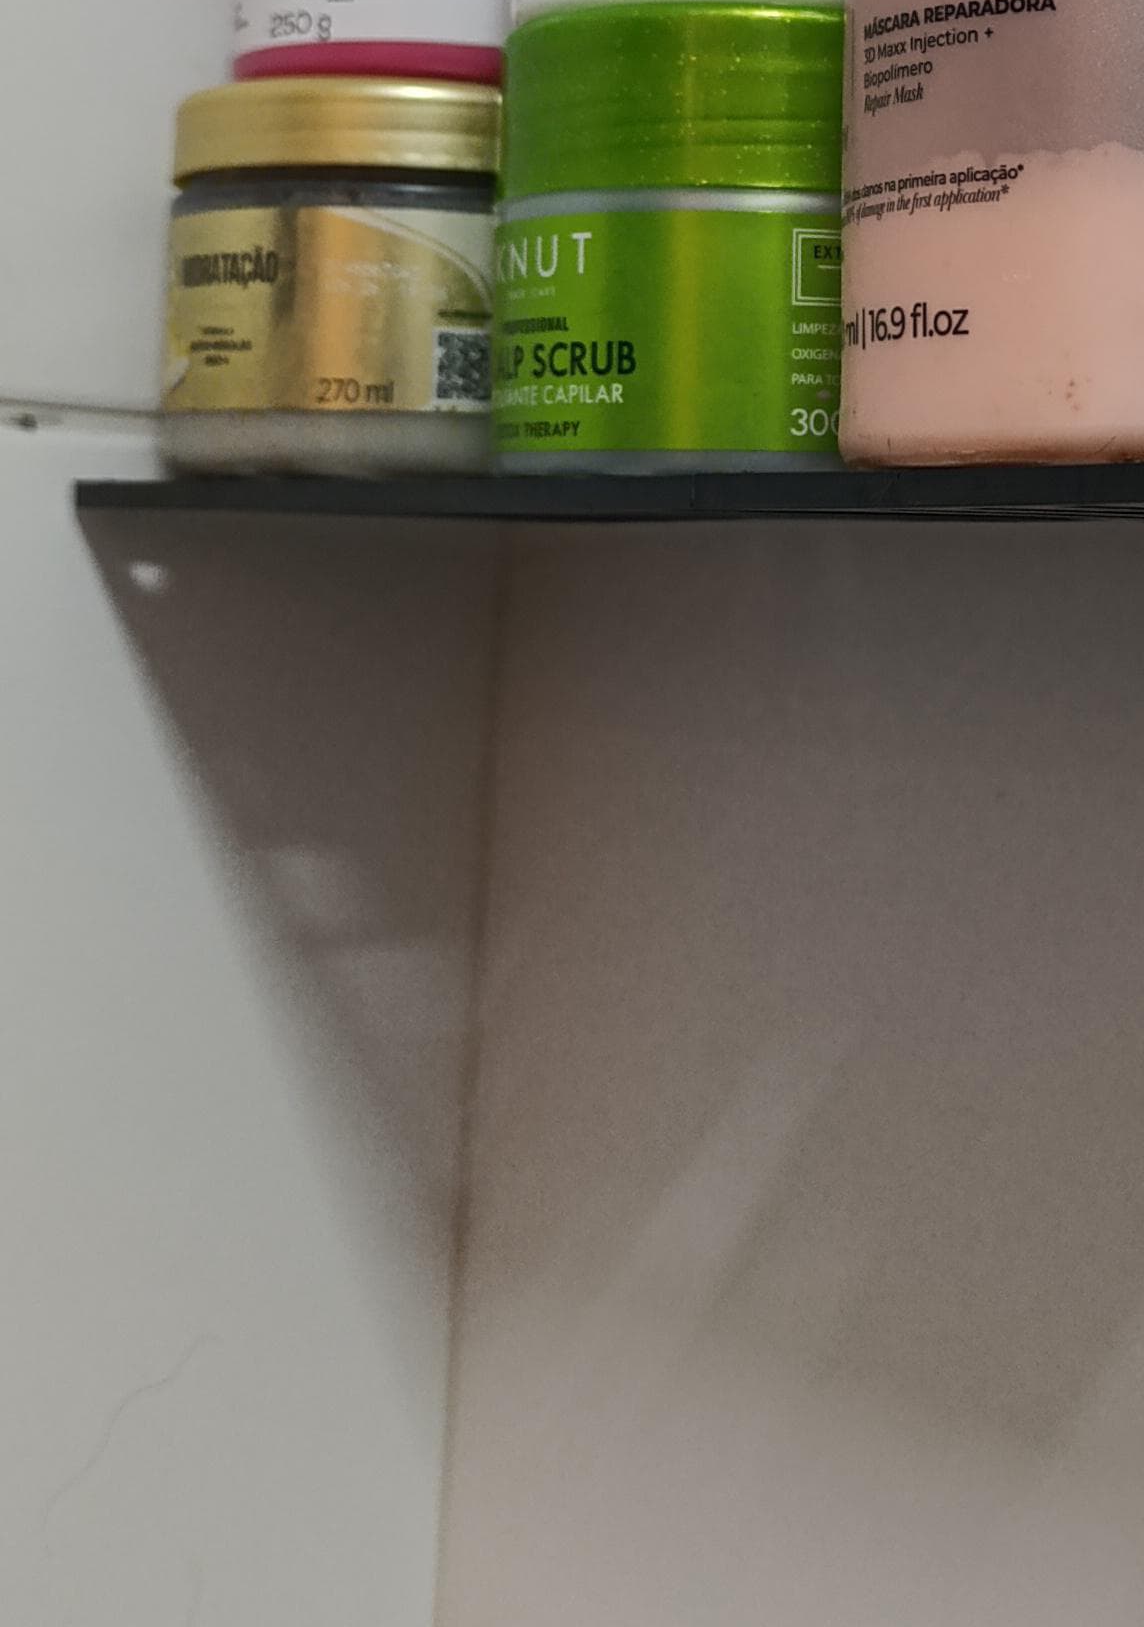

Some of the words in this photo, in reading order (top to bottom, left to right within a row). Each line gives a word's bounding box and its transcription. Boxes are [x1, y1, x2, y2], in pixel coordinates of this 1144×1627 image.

[270, 10, 312, 37] 250
[317, 14, 332, 41] g
[864, 10, 920, 41] MÁSCARA
[878, 42, 906, 61] Maxx
[910, 27, 978, 53] Injection
[864, 60, 933, 89] Biopolímero
[864, 89, 891, 114] Repair
[893, 83, 924, 105] Mask
[885, 181, 896, 192] na
[898, 171, 946, 193] primeira
[887, 197, 895, 212] in
[897, 194, 909, 211] the
[910, 191, 931, 215] first
[792, 323, 841, 335] LIMPEZ
[869, 305, 905, 341] 16.9
[910, 303, 969, 337] fl.oz
[532, 340, 636, 378] SCRUB
[791, 348, 841, 361] OXIGEN
[315, 378, 361, 403] 270
[791, 373, 819, 386] PARA
[543, 383, 624, 405] CAPILAR
[525, 421, 580, 438] THERAPY
